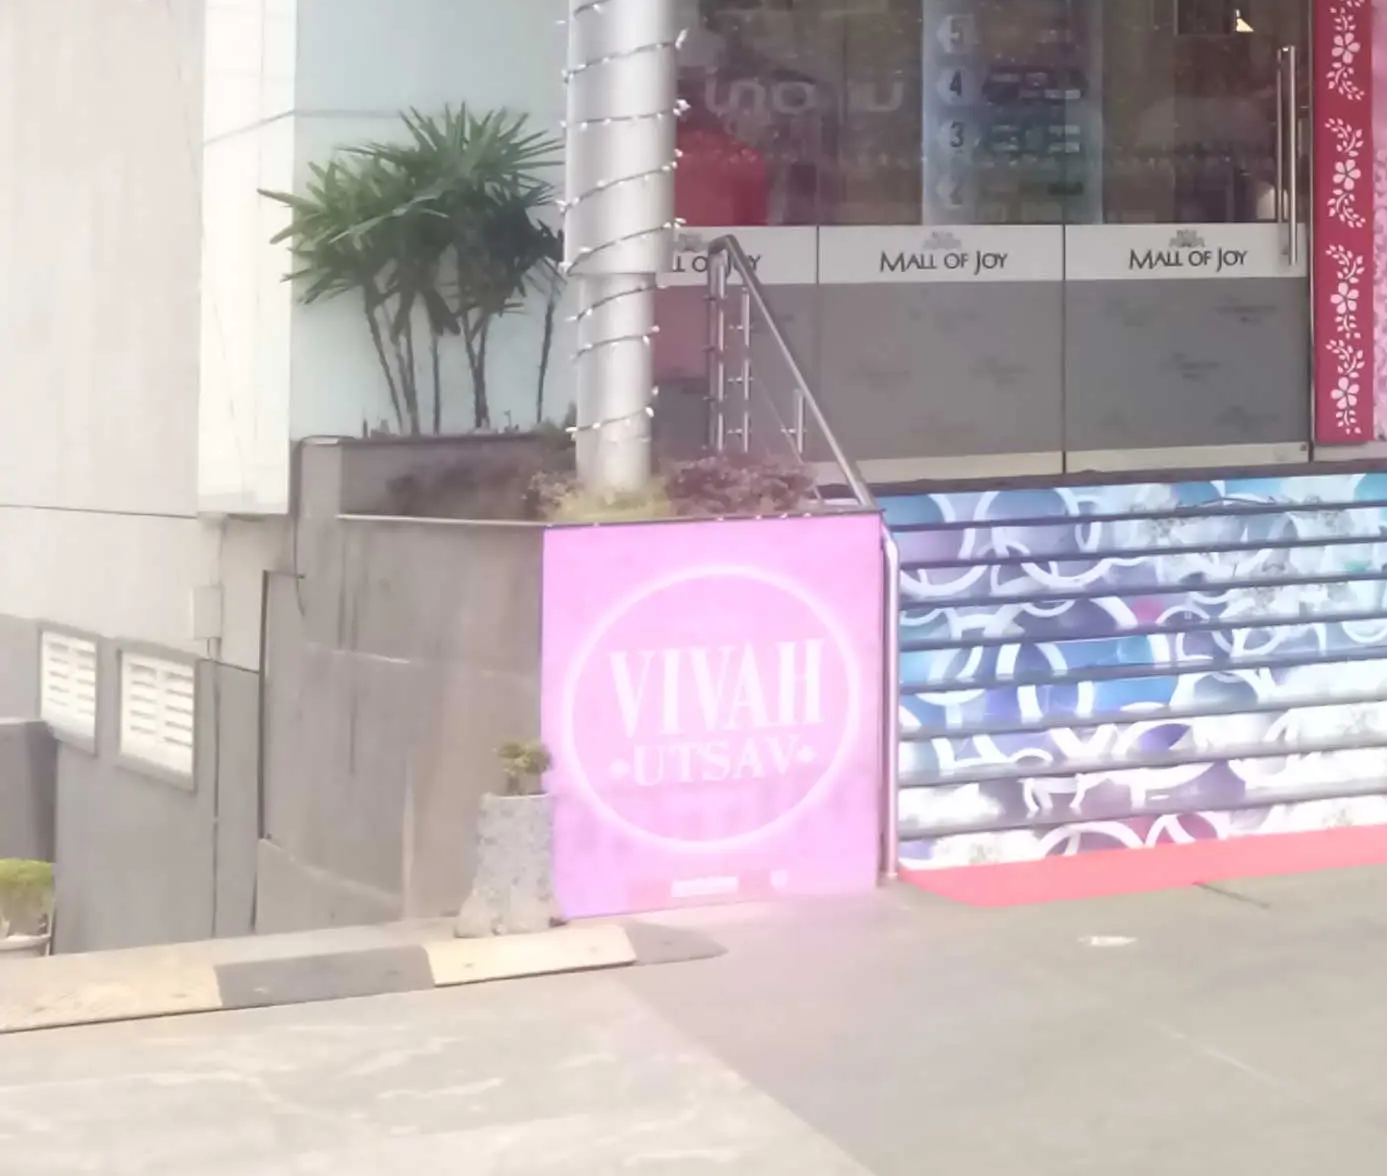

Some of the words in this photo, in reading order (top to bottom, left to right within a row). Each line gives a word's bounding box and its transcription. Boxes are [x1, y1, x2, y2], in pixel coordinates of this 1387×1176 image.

[949, 122, 964, 148] 3
[880, 250, 938, 274] MALL
[943, 252, 969, 271] OF
[974, 250, 1008, 275] JOY
[1128, 248, 1183, 270] MALL
[1188, 249, 1212, 267] OF
[1216, 246, 1248, 272] JOY
[609, 640, 824, 738] VIVAH
[633, 735, 799, 787] UTSAV
